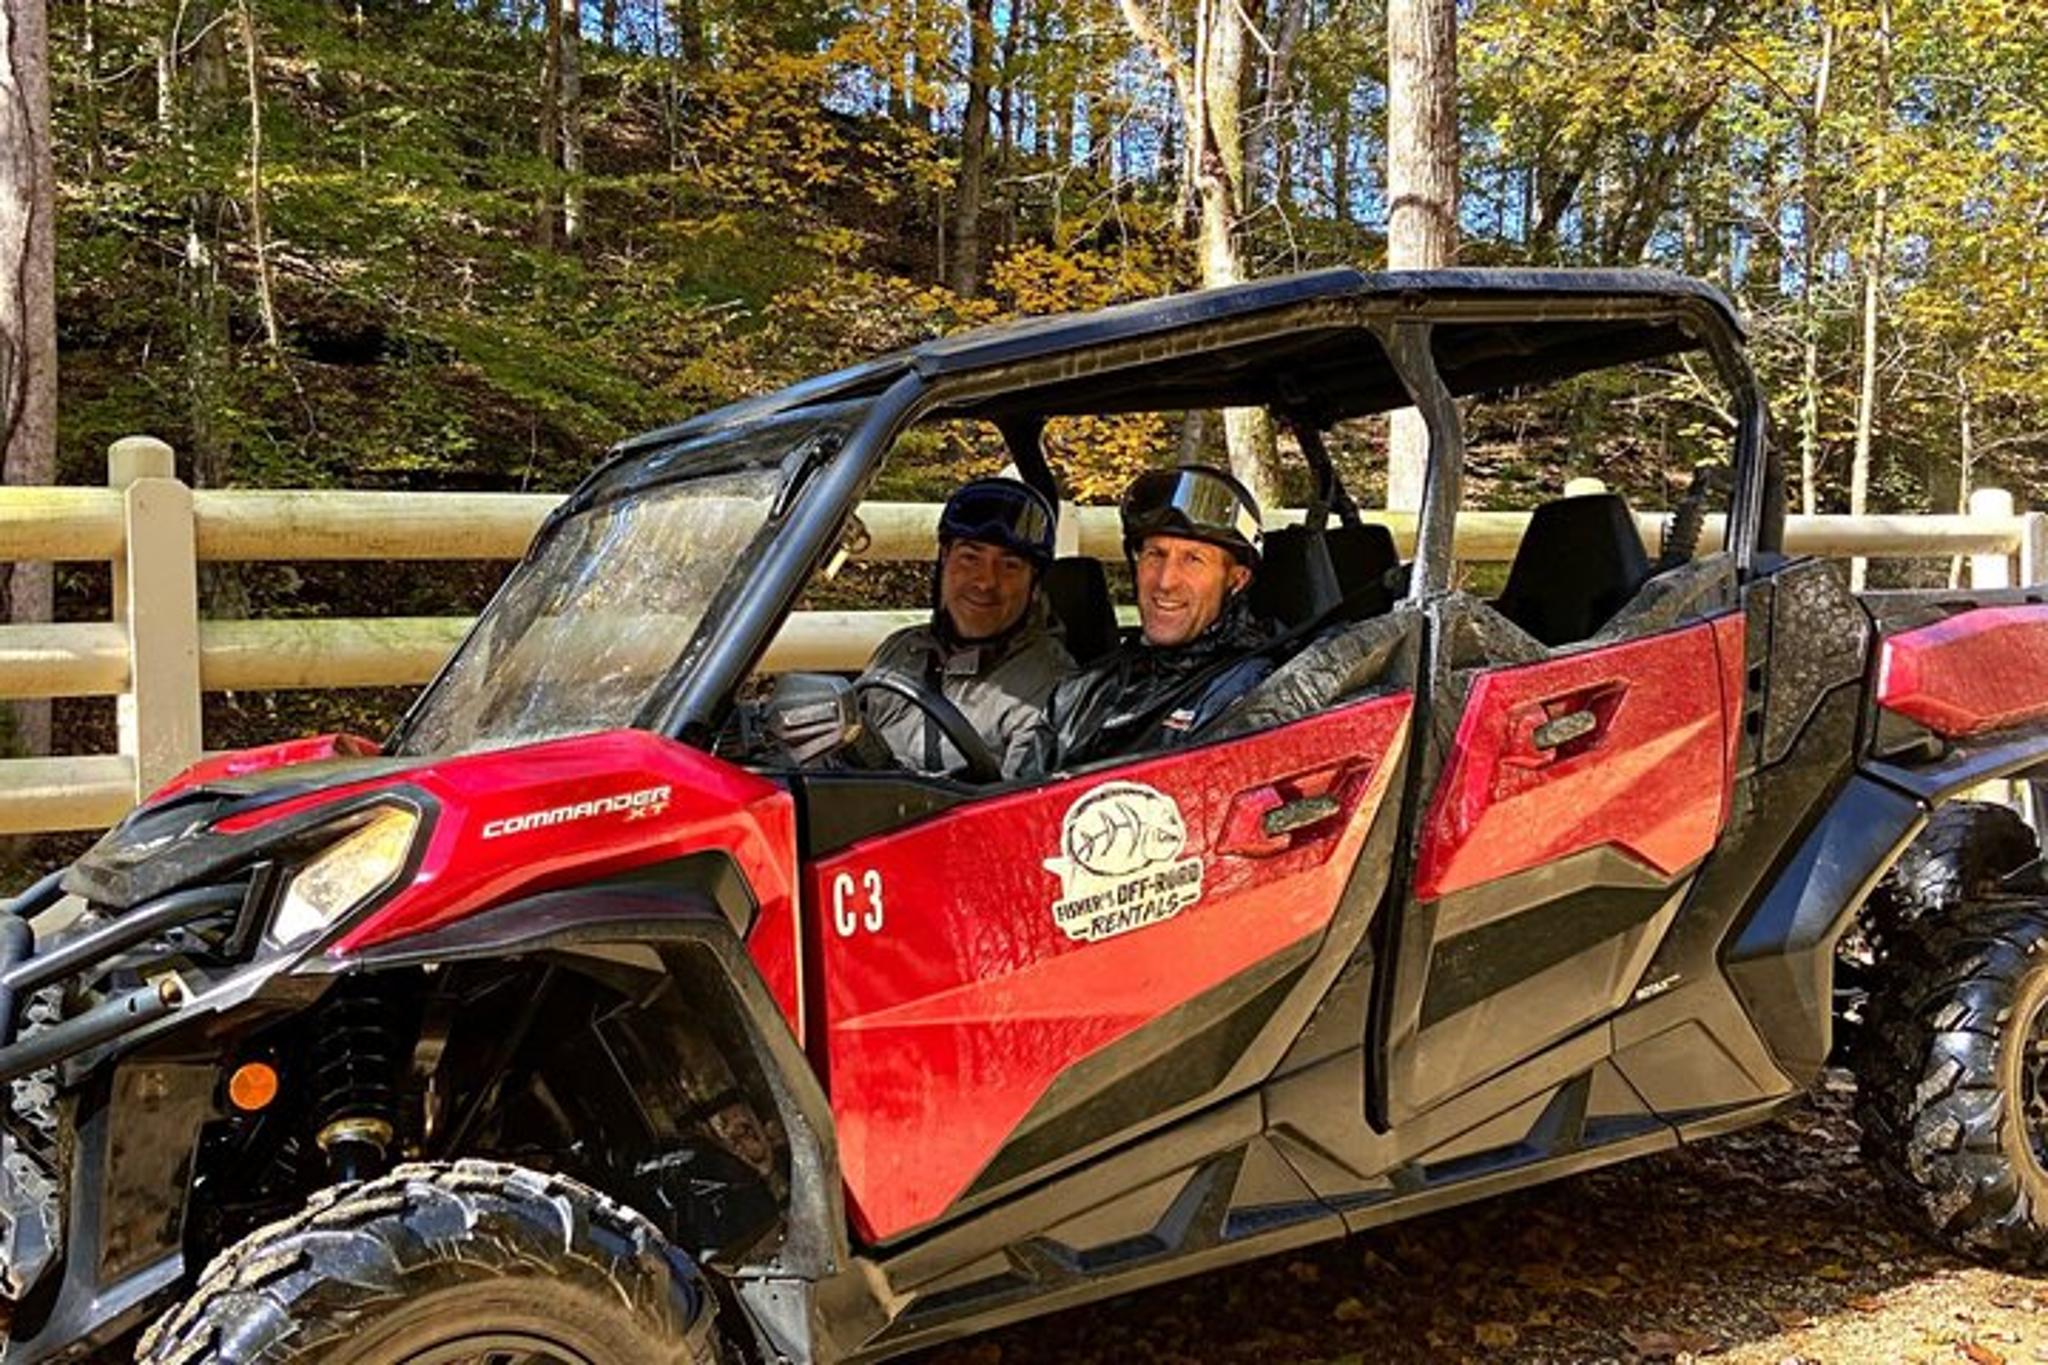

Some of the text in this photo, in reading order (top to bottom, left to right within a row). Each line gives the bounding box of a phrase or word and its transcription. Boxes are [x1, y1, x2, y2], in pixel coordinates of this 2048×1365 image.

[482, 785, 672, 839] COMMANDER
[622, 802, 670, 822] XT
[1091, 893, 1178, 937] RENTALS
